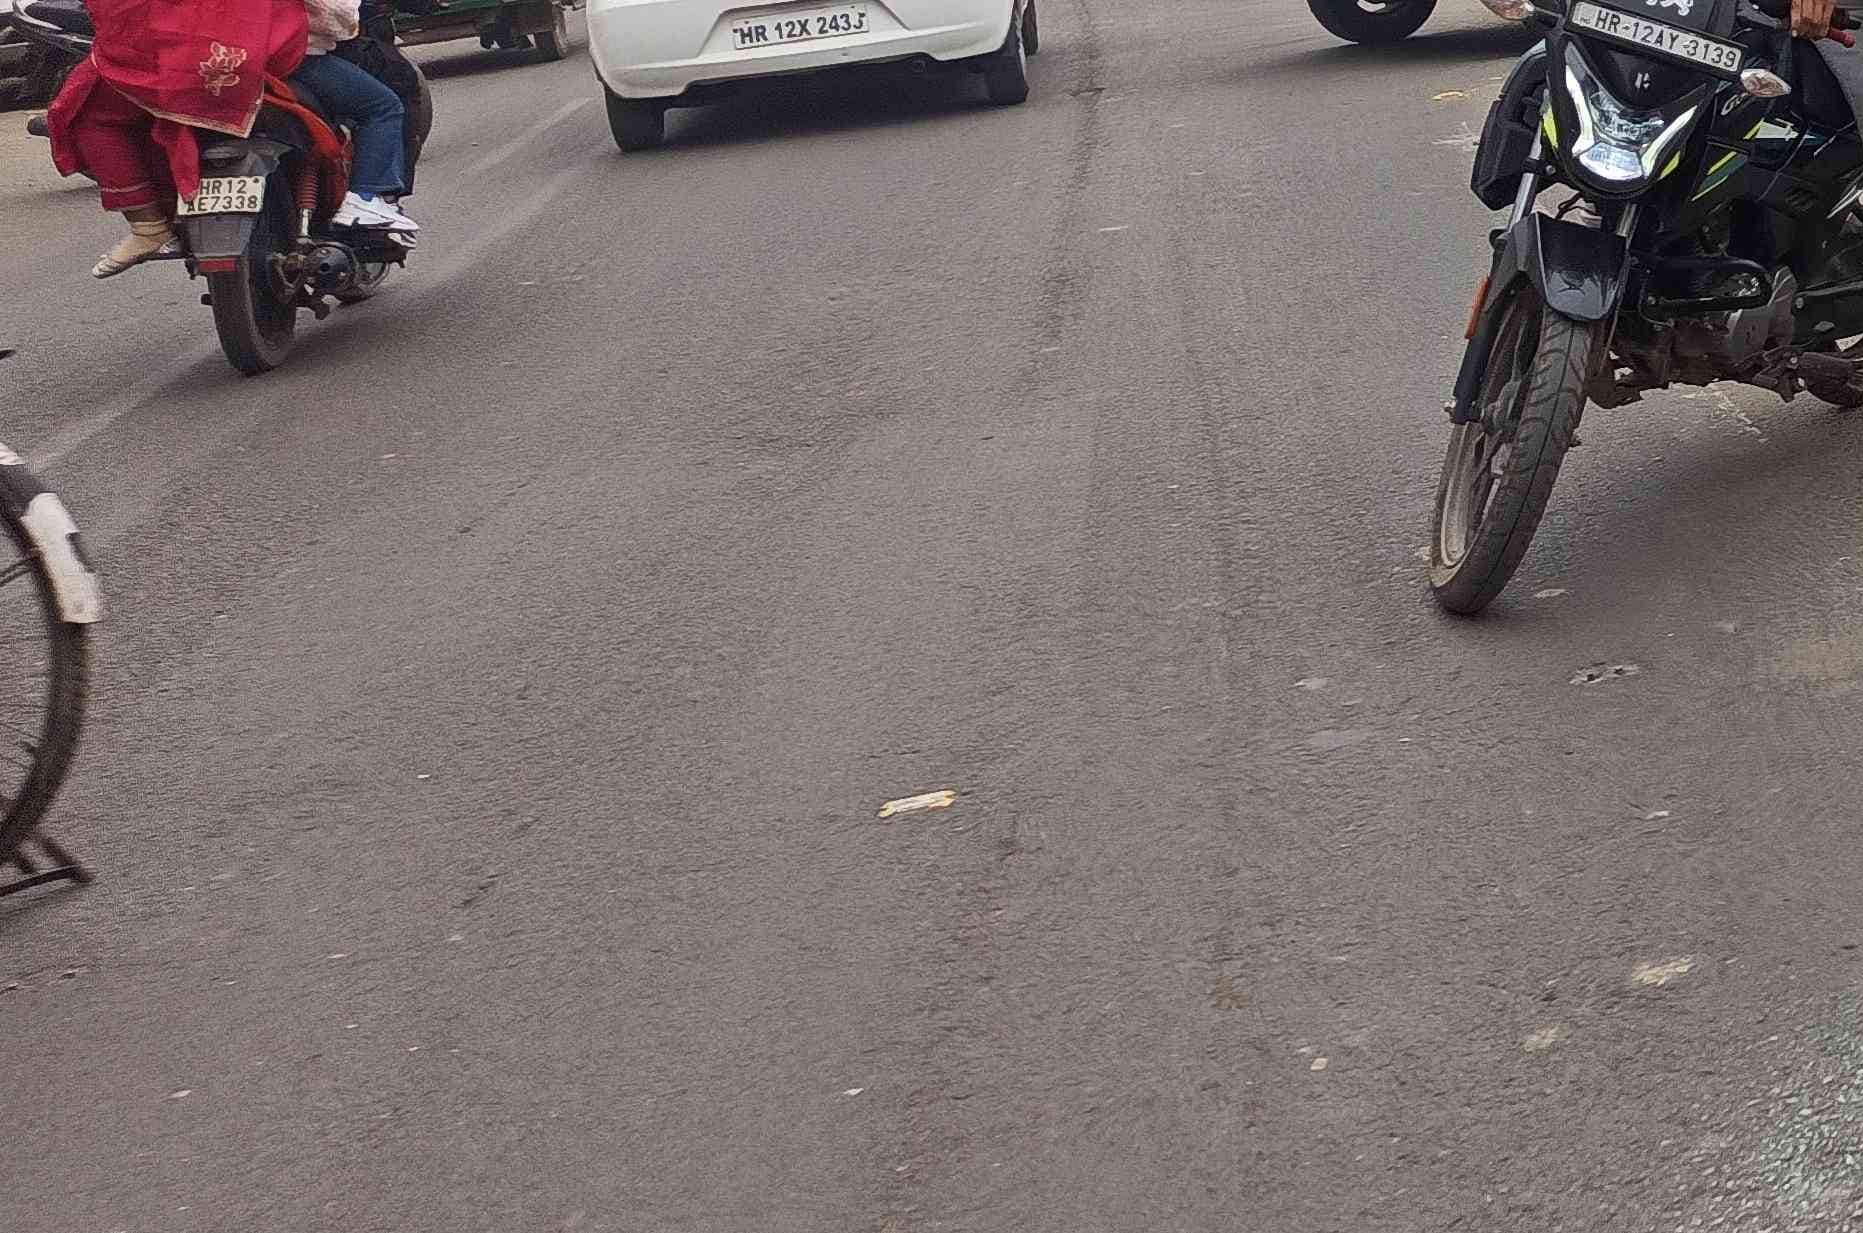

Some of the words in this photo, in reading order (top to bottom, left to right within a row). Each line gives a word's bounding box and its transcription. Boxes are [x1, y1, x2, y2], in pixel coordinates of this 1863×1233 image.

[738, 24, 769, 45] HR
[775, 18, 812, 40] 12X
[200, 179, 248, 196] HR12
